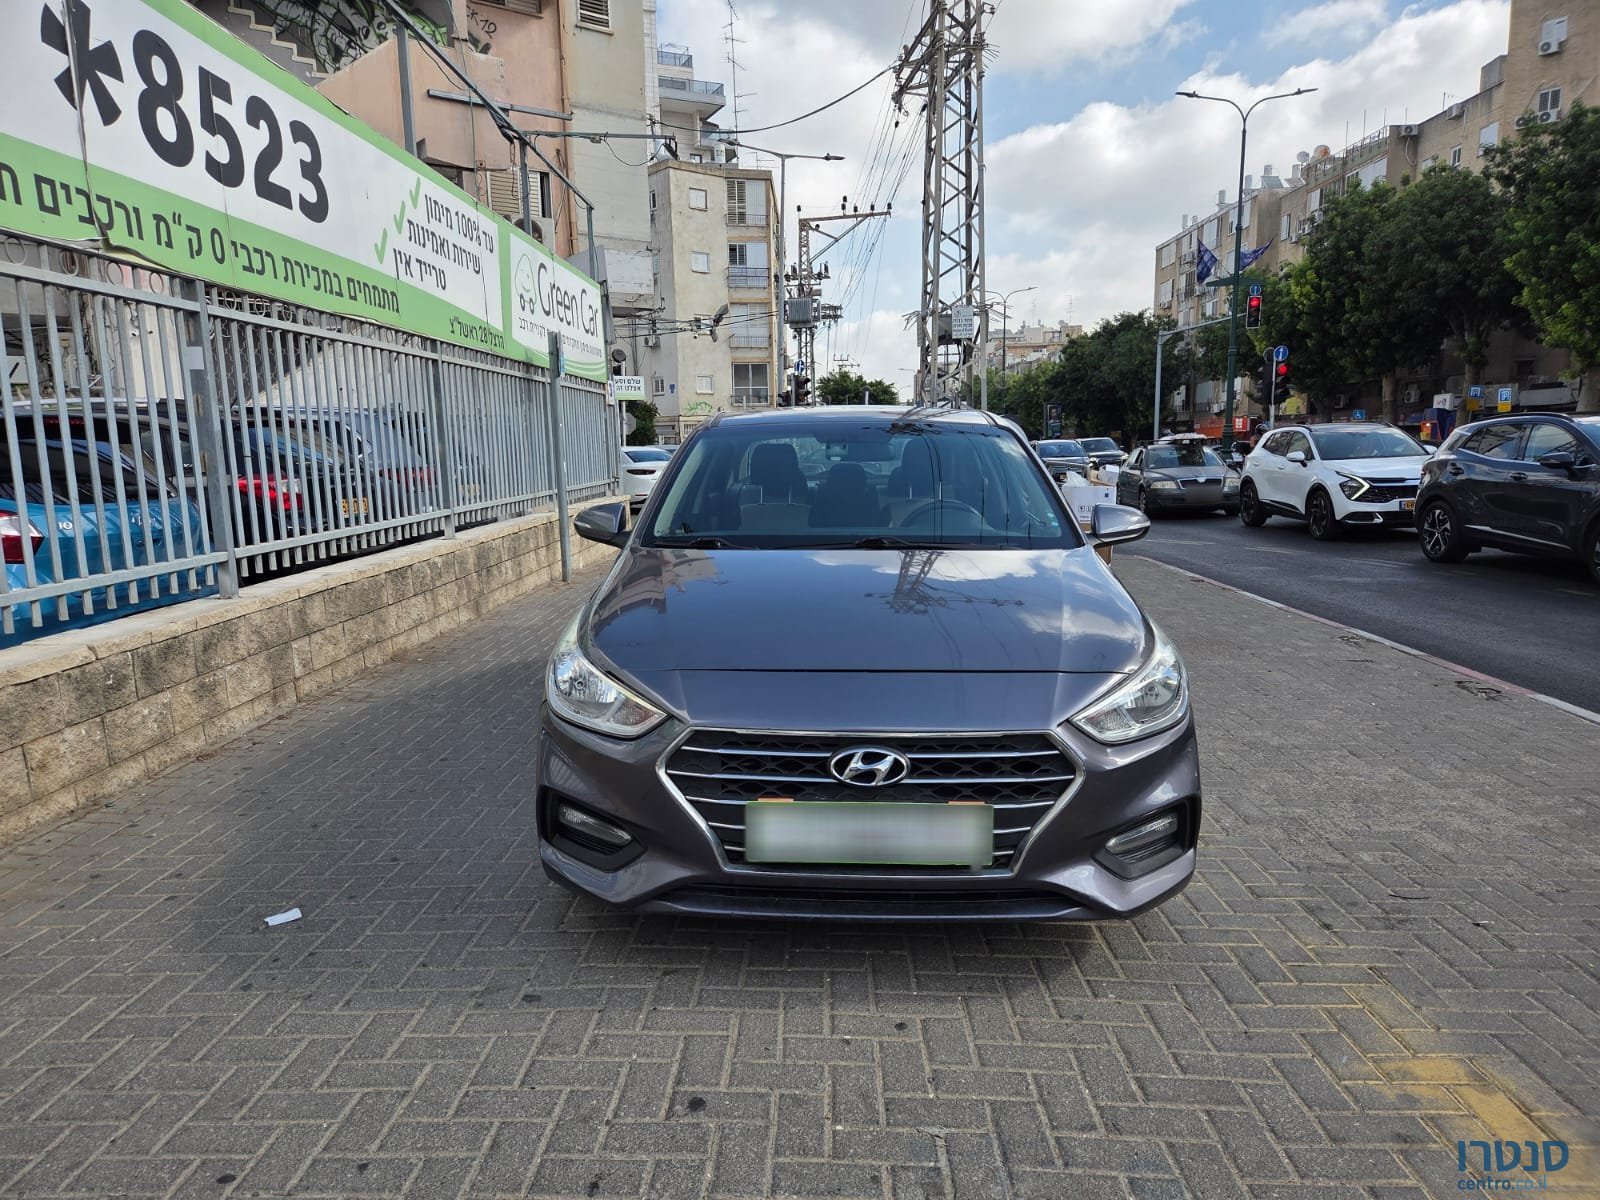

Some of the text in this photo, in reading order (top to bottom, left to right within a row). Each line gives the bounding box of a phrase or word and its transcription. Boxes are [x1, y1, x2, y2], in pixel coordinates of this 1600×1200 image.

[33, 173, 144, 241] ורכבים
[424, 193, 494, 254] עד 100% מימון
[152, 210, 203, 260] ק"מ
[209, 227, 225, 265] 0
[407, 218, 481, 275] שירות ואמינות
[231, 239, 278, 280] רכבי
[281, 255, 344, 298] במכירת
[393, 248, 447, 291] טרייד אין
[347, 276, 400, 314] מתמחים
[537, 262, 599, 338] Green Car
[478, 325, 488, 344] 28
